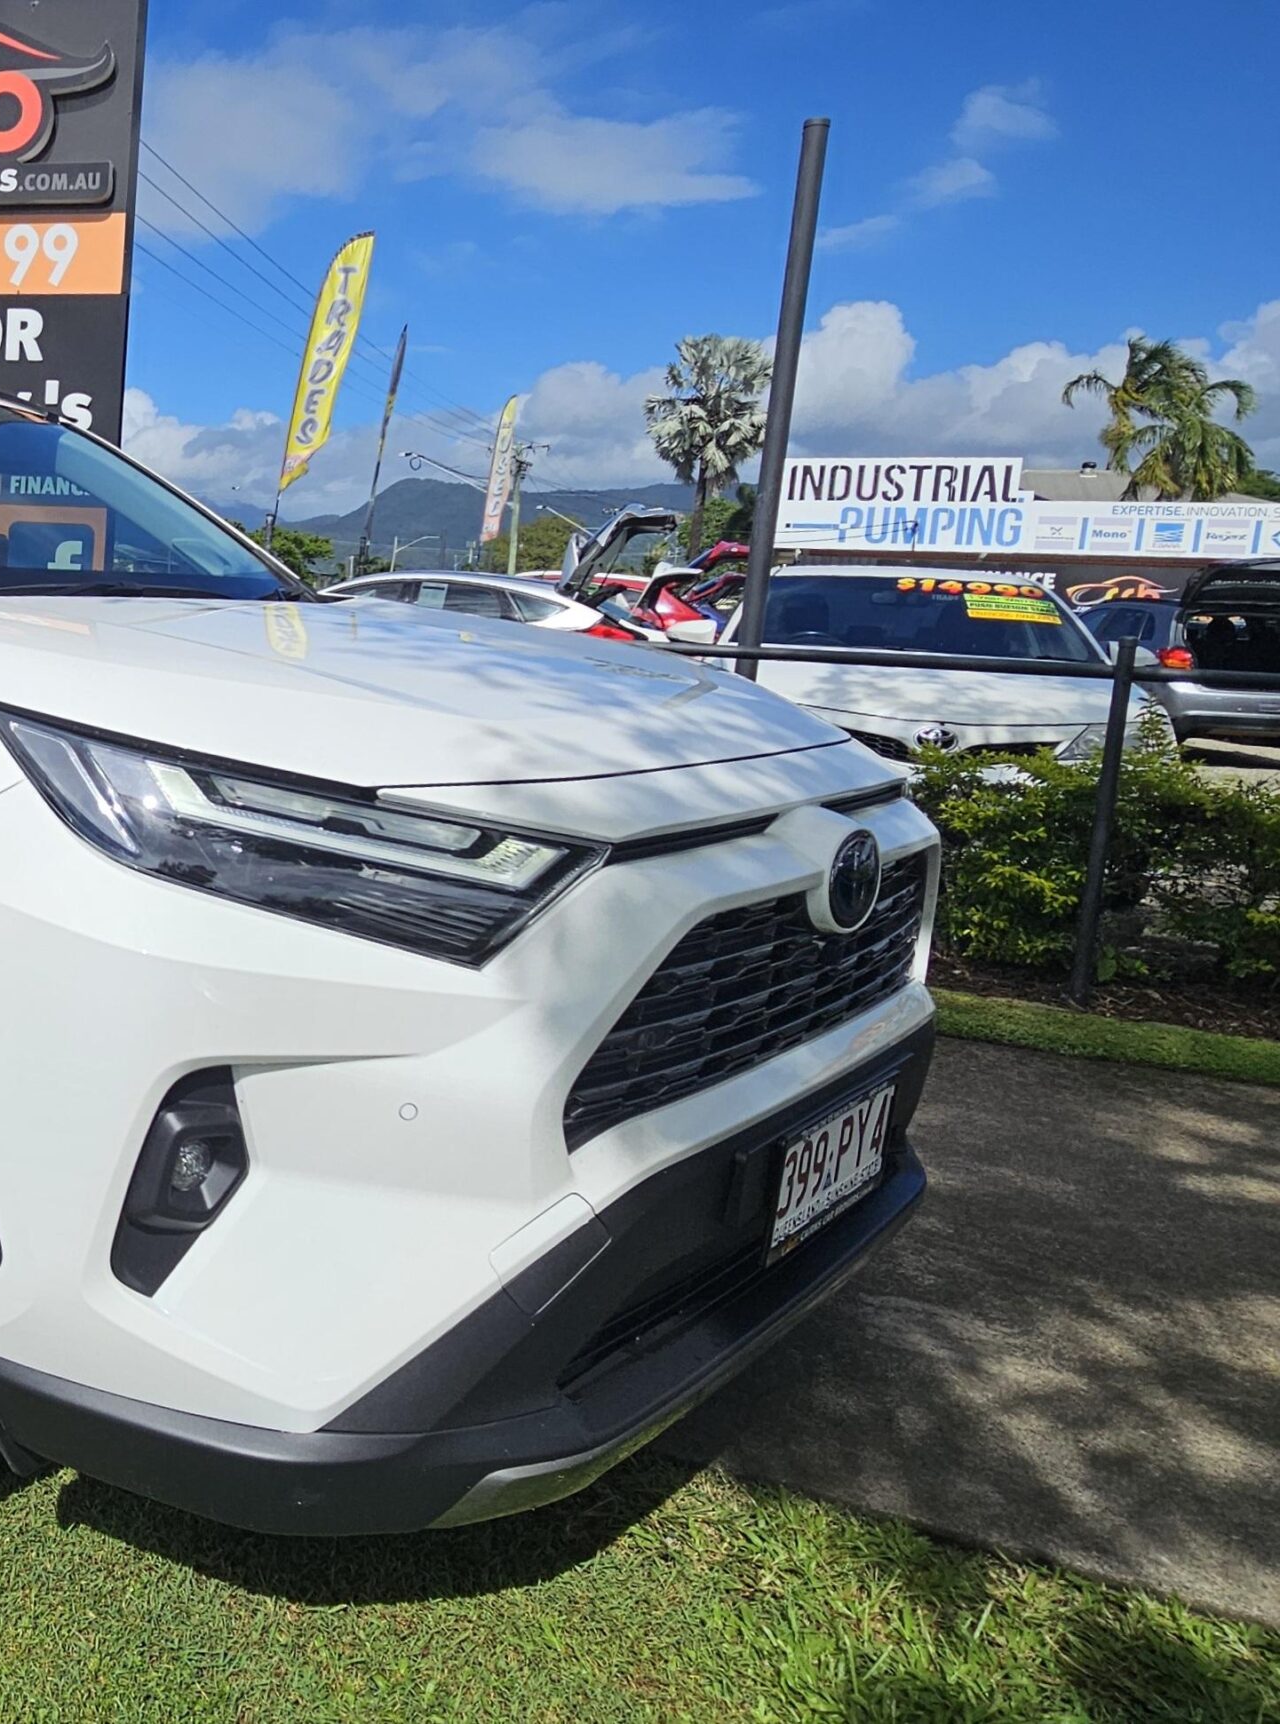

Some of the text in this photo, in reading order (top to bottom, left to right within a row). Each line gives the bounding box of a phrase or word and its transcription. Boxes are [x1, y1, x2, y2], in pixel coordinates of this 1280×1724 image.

[295, 265, 358, 445] TRADES
[787, 464, 1019, 503] INDUSTRIAL
[837, 506, 1024, 547] PUMPING
[1091, 529, 1128, 539] Mono
[896, 577, 1044, 599] $14990
